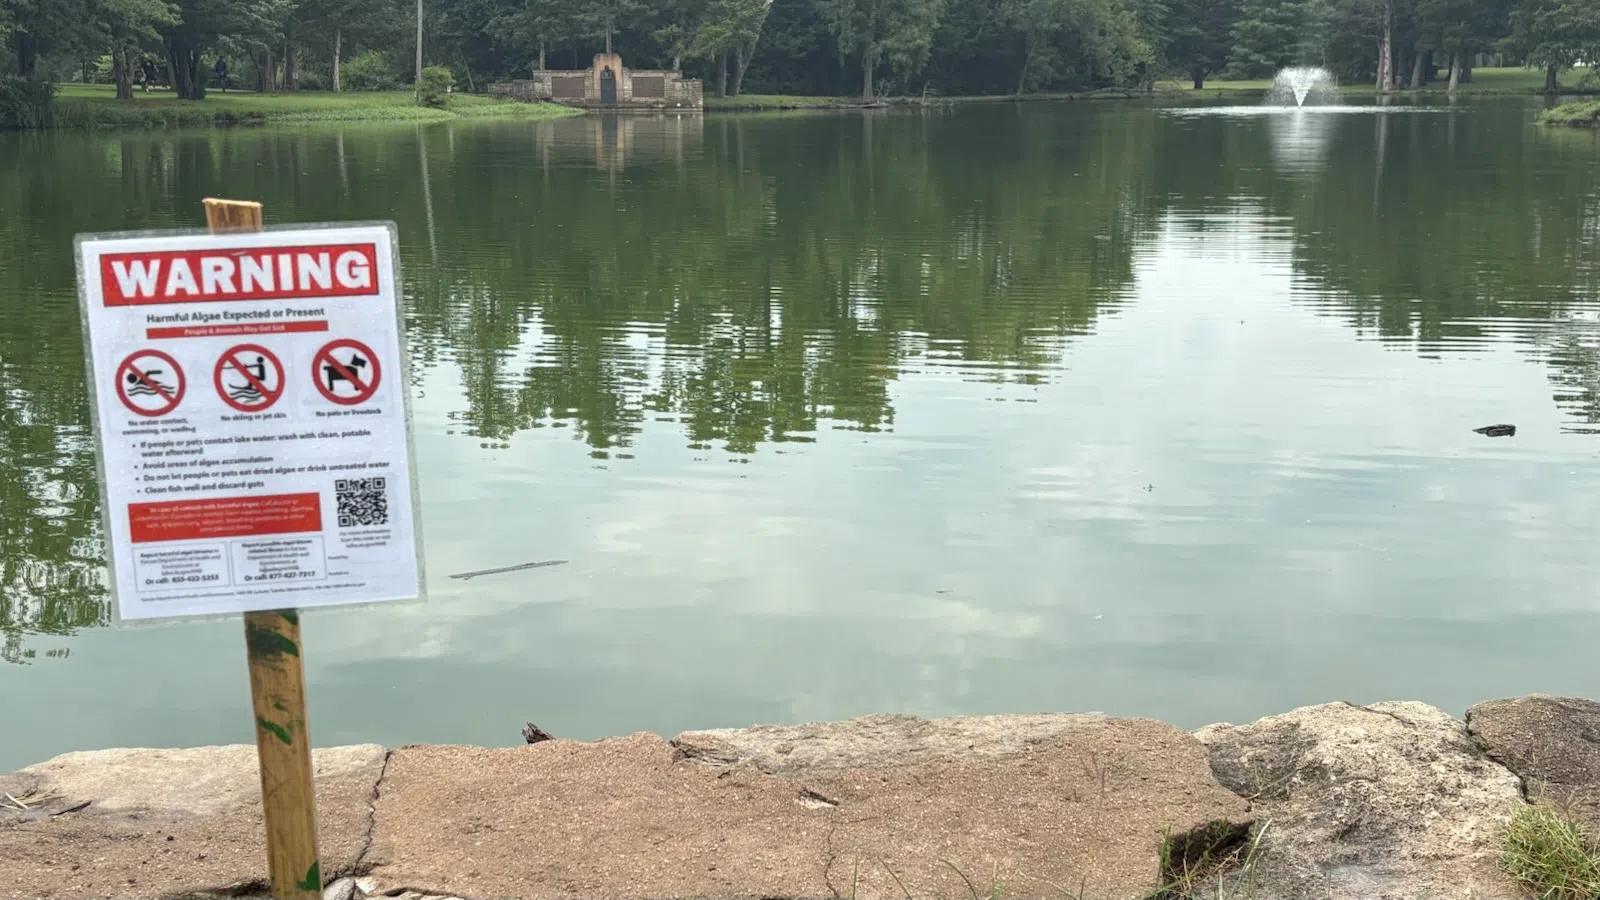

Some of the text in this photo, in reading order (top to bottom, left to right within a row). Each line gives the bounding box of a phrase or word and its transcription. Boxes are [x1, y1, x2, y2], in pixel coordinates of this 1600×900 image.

[111, 250, 371, 298] WARNING
[146, 308, 325, 323] Harmful Algae Expected or Present
[140, 441, 147, 449] If
[147, 440, 174, 450] people
[185, 439, 203, 447] pets
[204, 437, 233, 445] contact
[278, 433, 298, 441] wash
[300, 432, 316, 440] with
[317, 431, 340, 439] clean,
[341, 429, 372, 439] potable
[141, 447, 204, 458] water afterward
[142, 456, 274, 470] Avoid areas of algae accumulation
[143, 474, 155, 482] Do
[156, 473, 170, 481] not
[171, 472, 182, 480] let
[183, 471, 210, 481] people
[221, 470, 238, 478] pets
[275, 466, 296, 475] algae
[307, 464, 327, 473] drink
[328, 462, 367, 471] untreated
[368, 461, 390, 469] water
[144, 481, 265, 494] Clean fish well and discard guts
